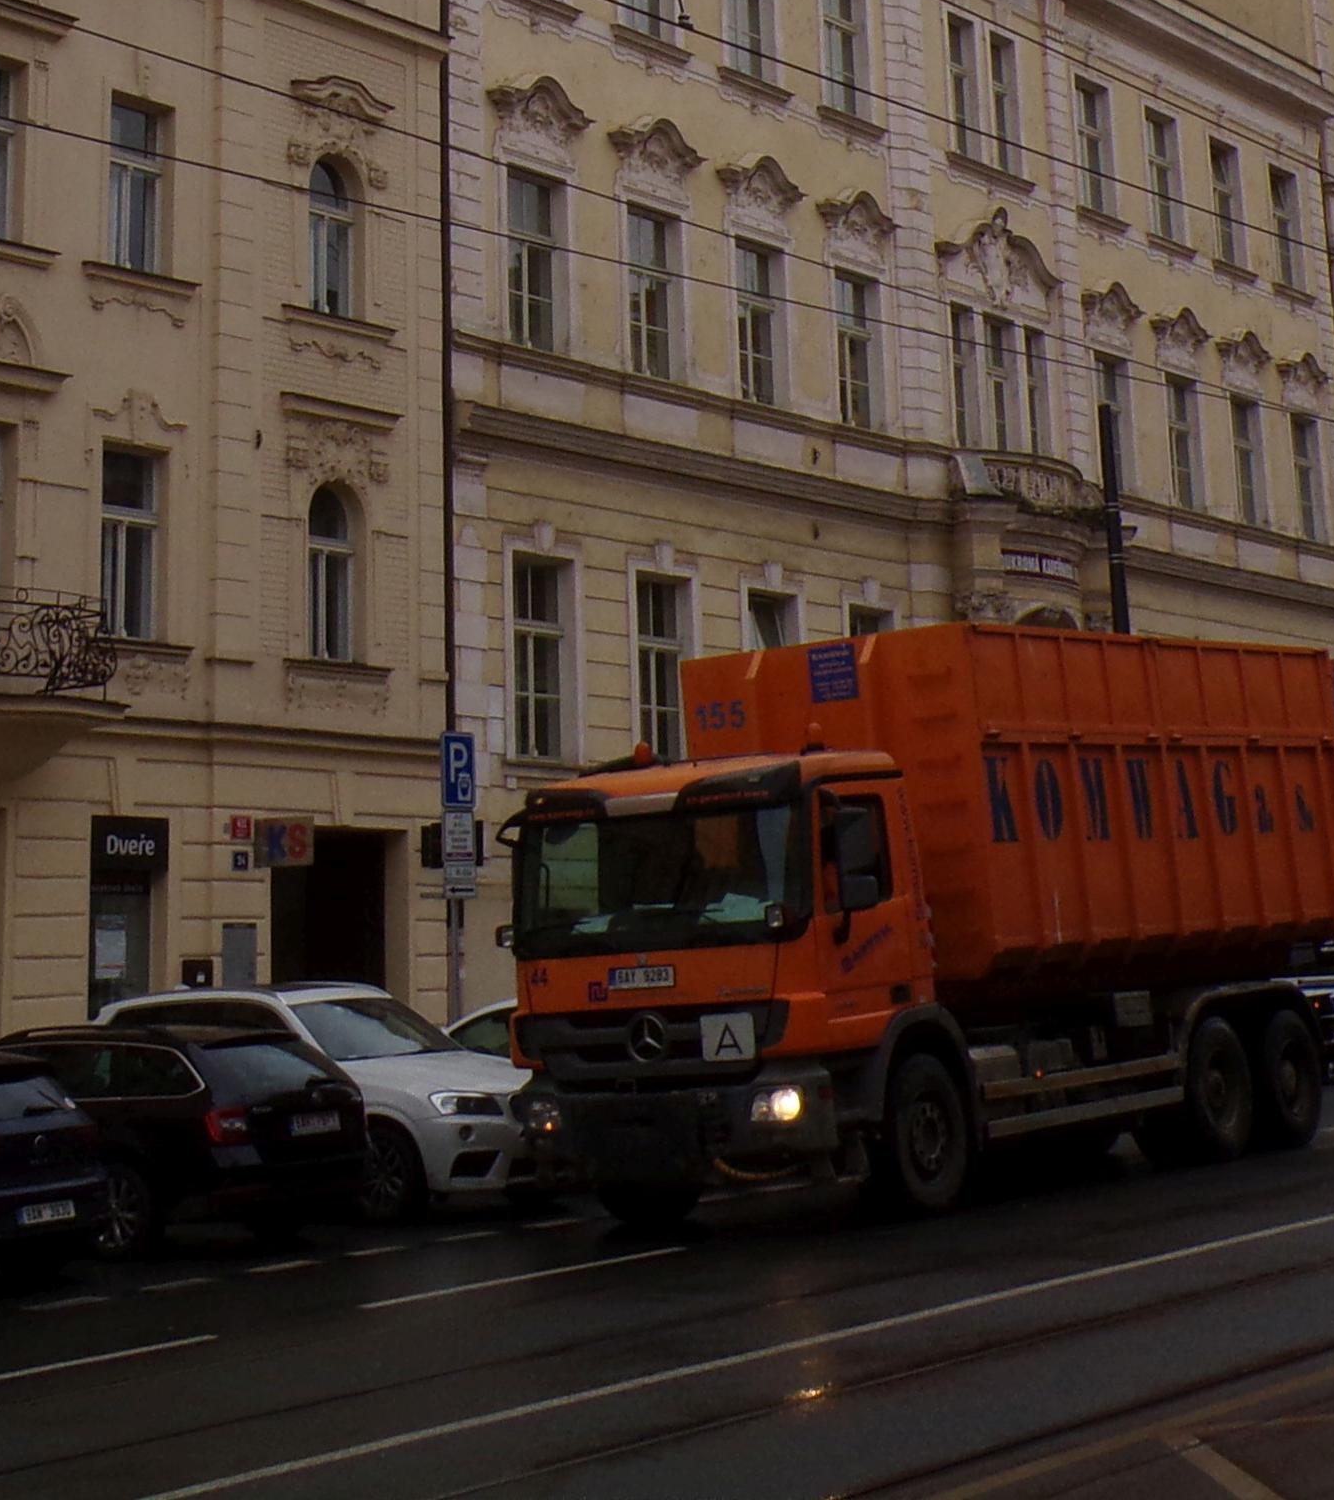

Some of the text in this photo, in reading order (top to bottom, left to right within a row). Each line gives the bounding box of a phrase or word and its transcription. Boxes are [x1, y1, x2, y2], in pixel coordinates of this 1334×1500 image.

[695, 699, 746, 731] 155
[449, 741, 468, 784] P
[983, 756, 1238, 842] KOMWAG
[106, 833, 156, 857] Dveře
[267, 823, 307, 861] KS
[530, 967, 549, 986] 44
[715, 1023, 743, 1056] A
